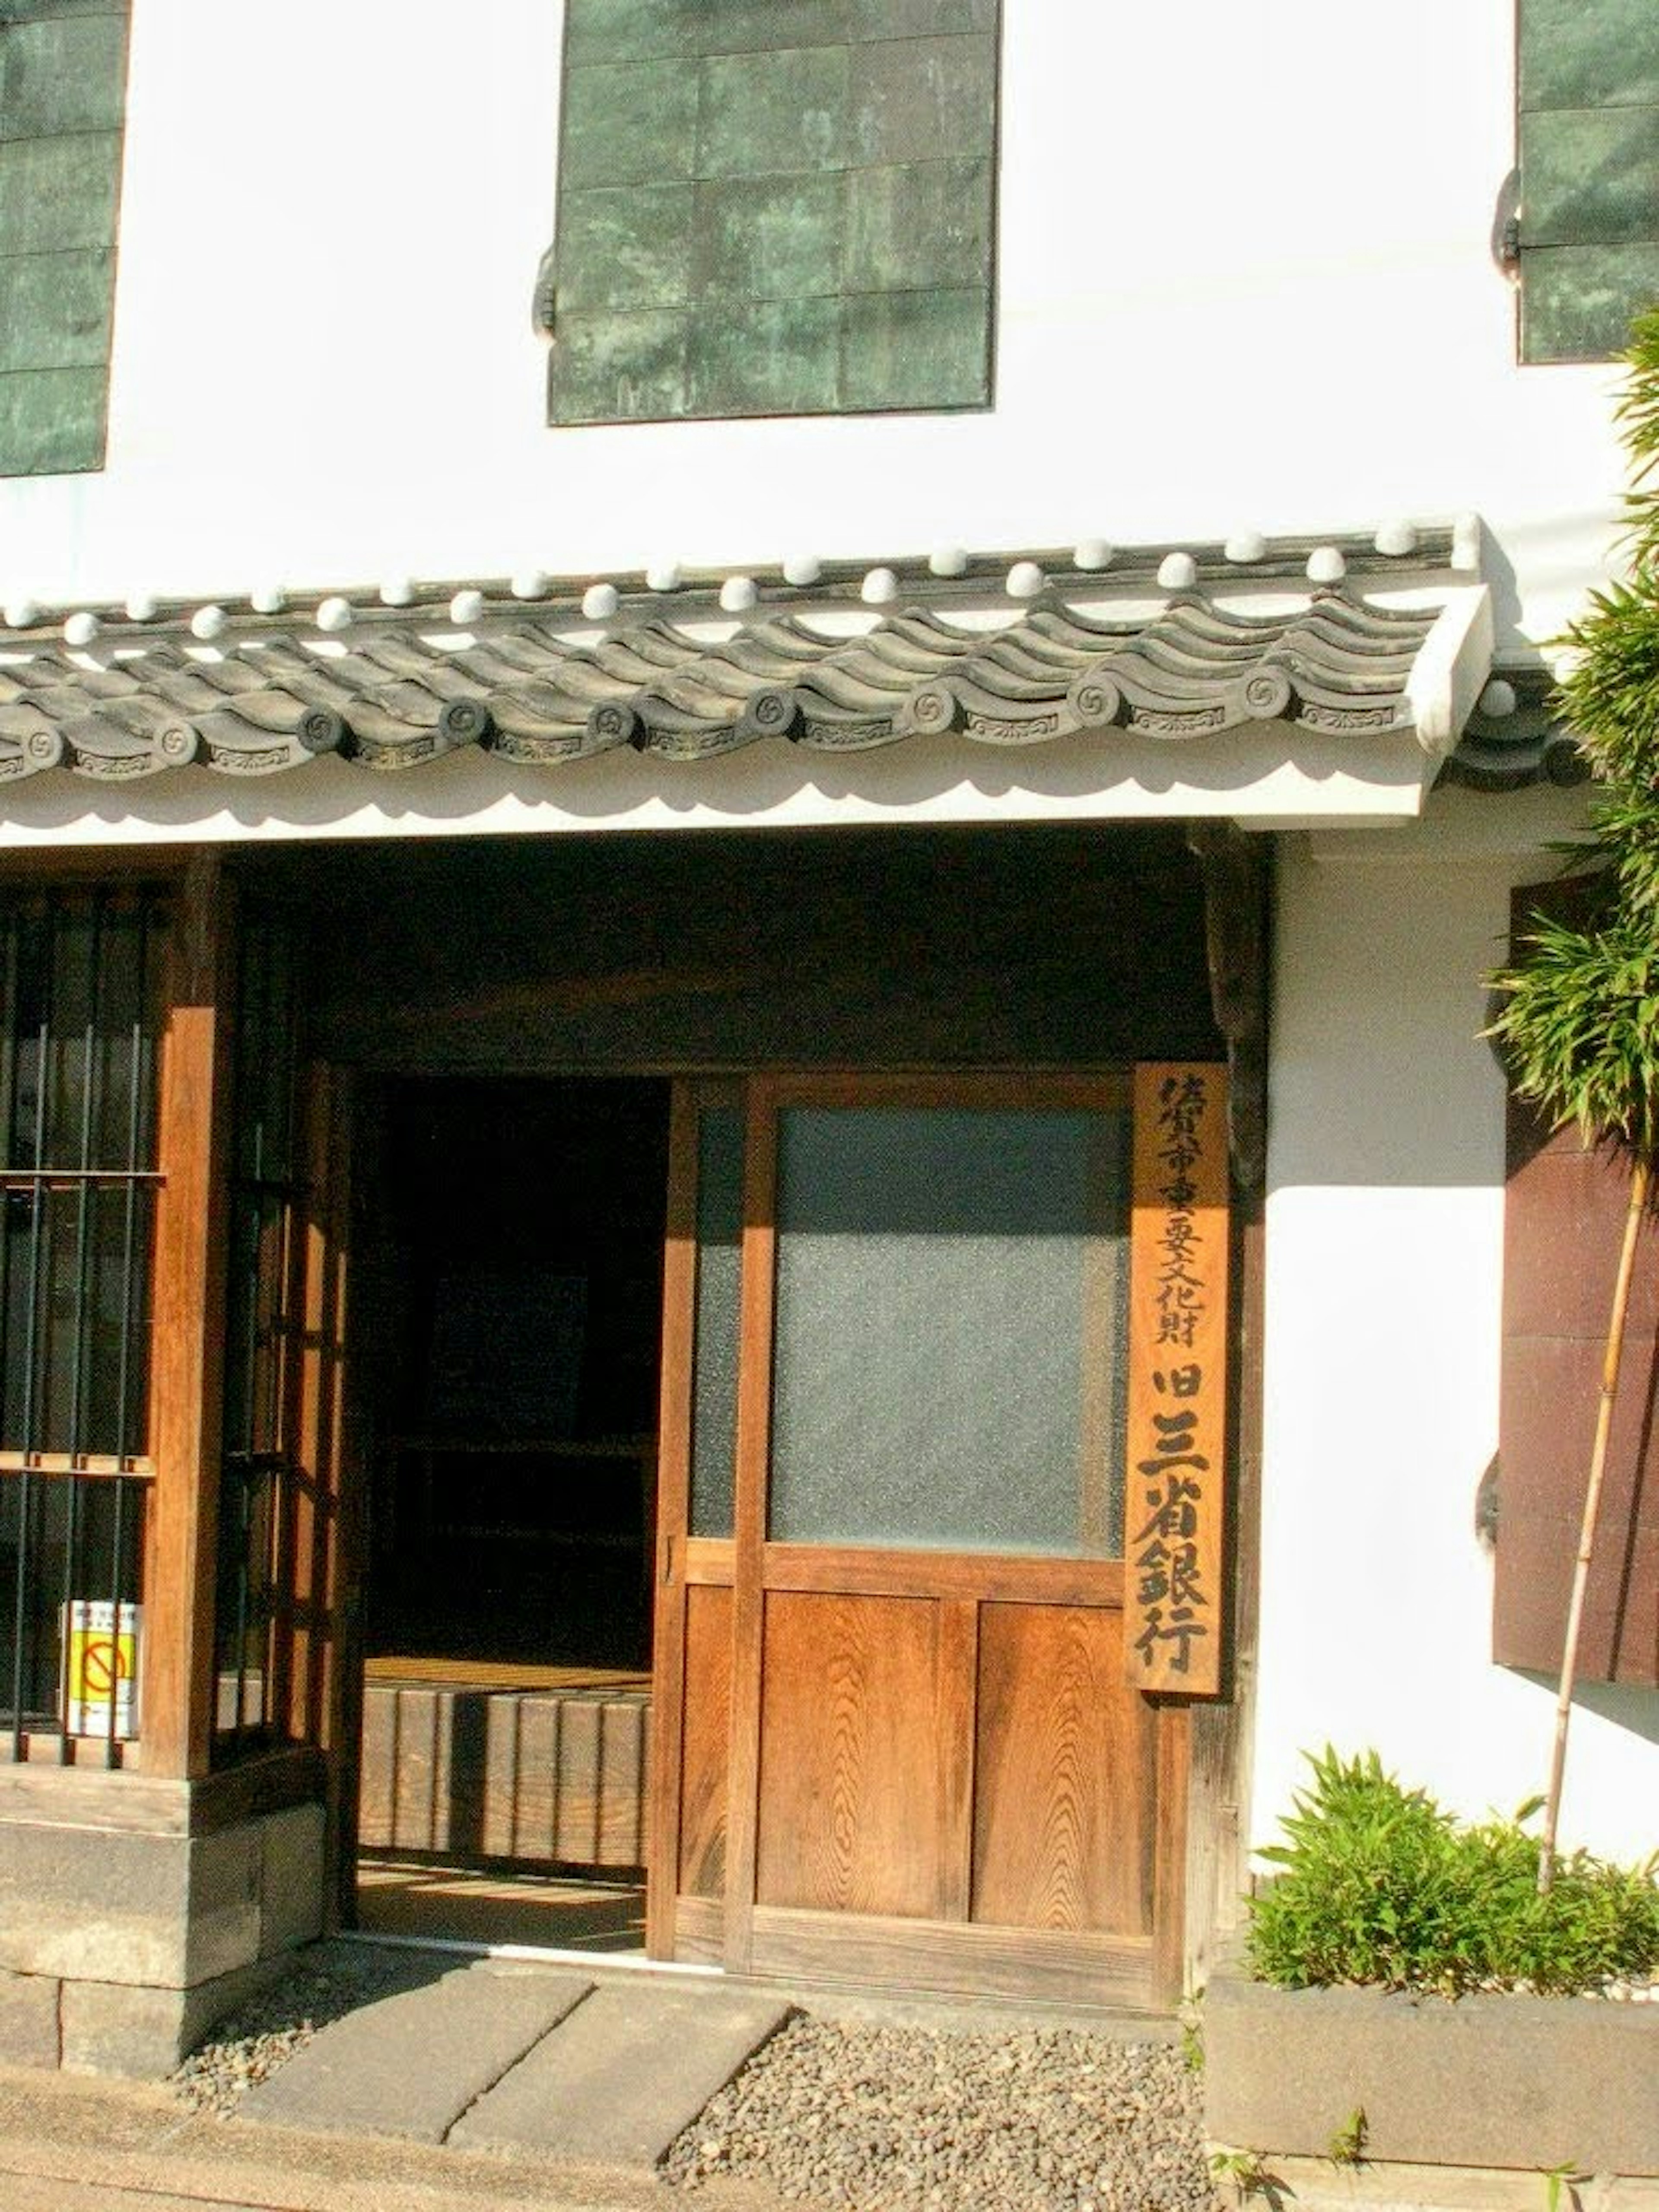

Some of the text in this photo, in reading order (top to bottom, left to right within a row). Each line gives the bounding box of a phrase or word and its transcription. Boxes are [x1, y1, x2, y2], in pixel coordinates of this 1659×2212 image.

[1131, 1363, 1210, 1673] 旧三省銀行
